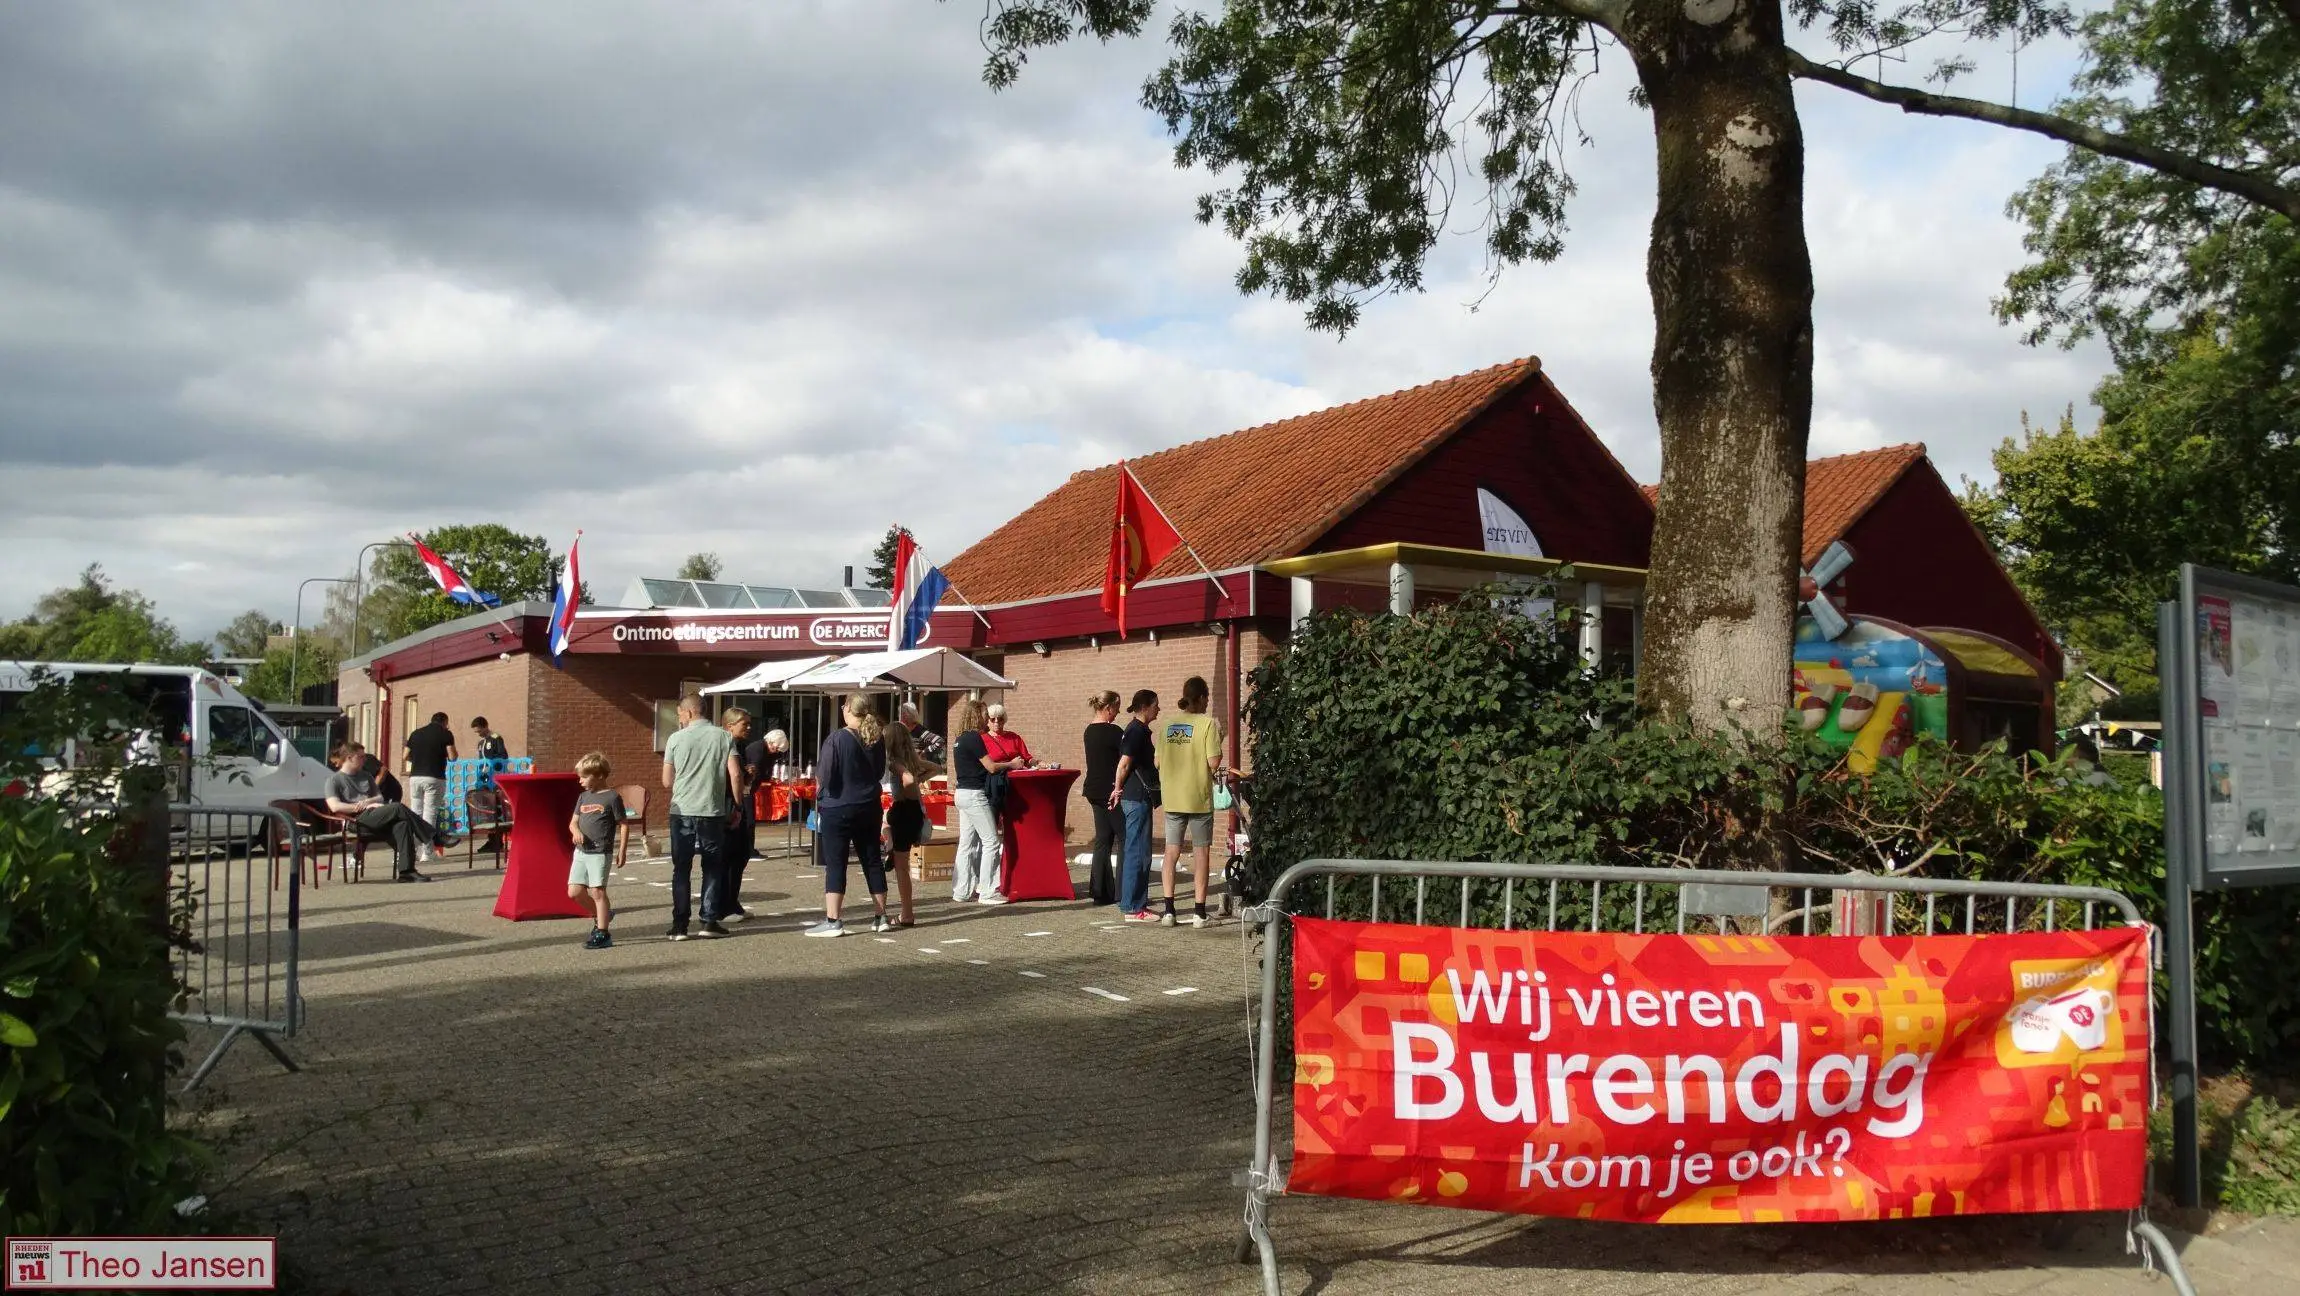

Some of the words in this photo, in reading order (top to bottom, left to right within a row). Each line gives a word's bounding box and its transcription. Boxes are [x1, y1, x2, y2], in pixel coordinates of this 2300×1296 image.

[613, 624, 799, 643] Ontmoetingscentrum
[815, 625, 833, 638] DE
[1448, 968, 1551, 1042] Wij
[1566, 972, 1765, 1028] vieren
[1391, 1021, 1932, 1138] Burendag
[1519, 1141, 1652, 1189] Kom
[1656, 1139, 1713, 1198] je
[1727, 1127, 1852, 1182] ook?
